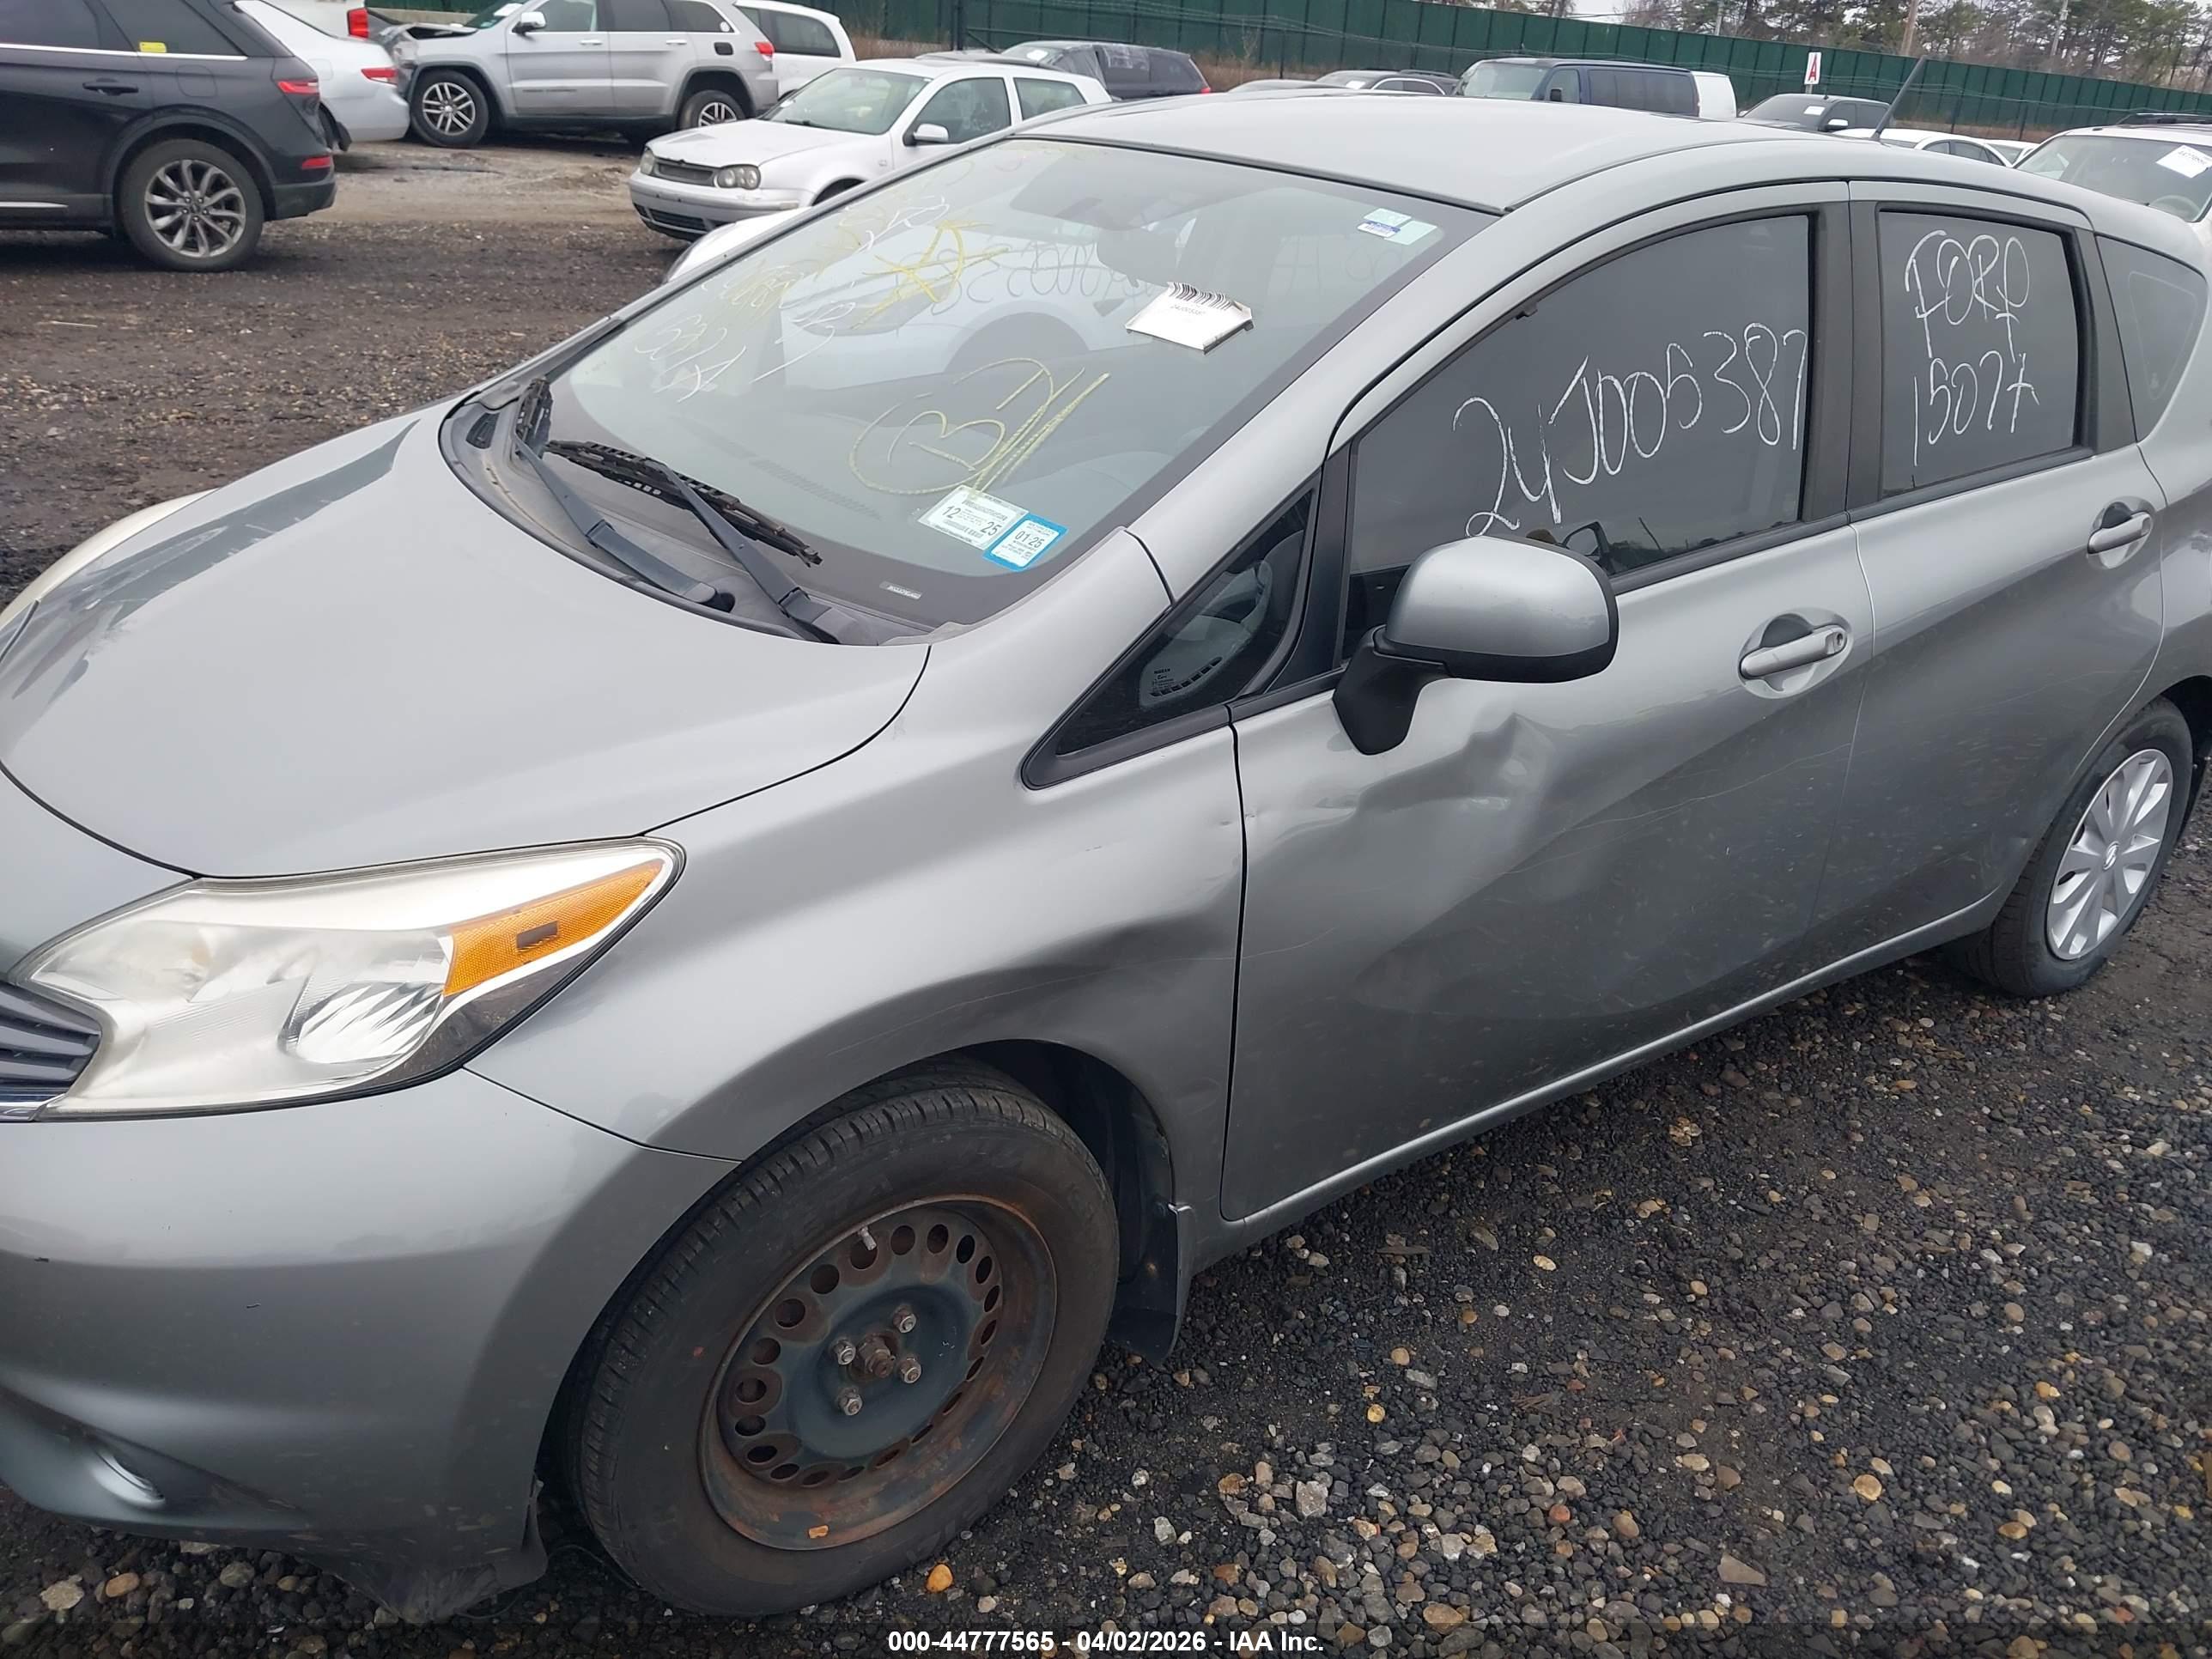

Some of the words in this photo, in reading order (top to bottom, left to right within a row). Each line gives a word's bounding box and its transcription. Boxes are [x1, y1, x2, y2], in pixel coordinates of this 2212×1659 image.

[1808, 53, 1817, 81] A
[942, 505, 962, 519] 12
[980, 521, 1002, 536] 25
